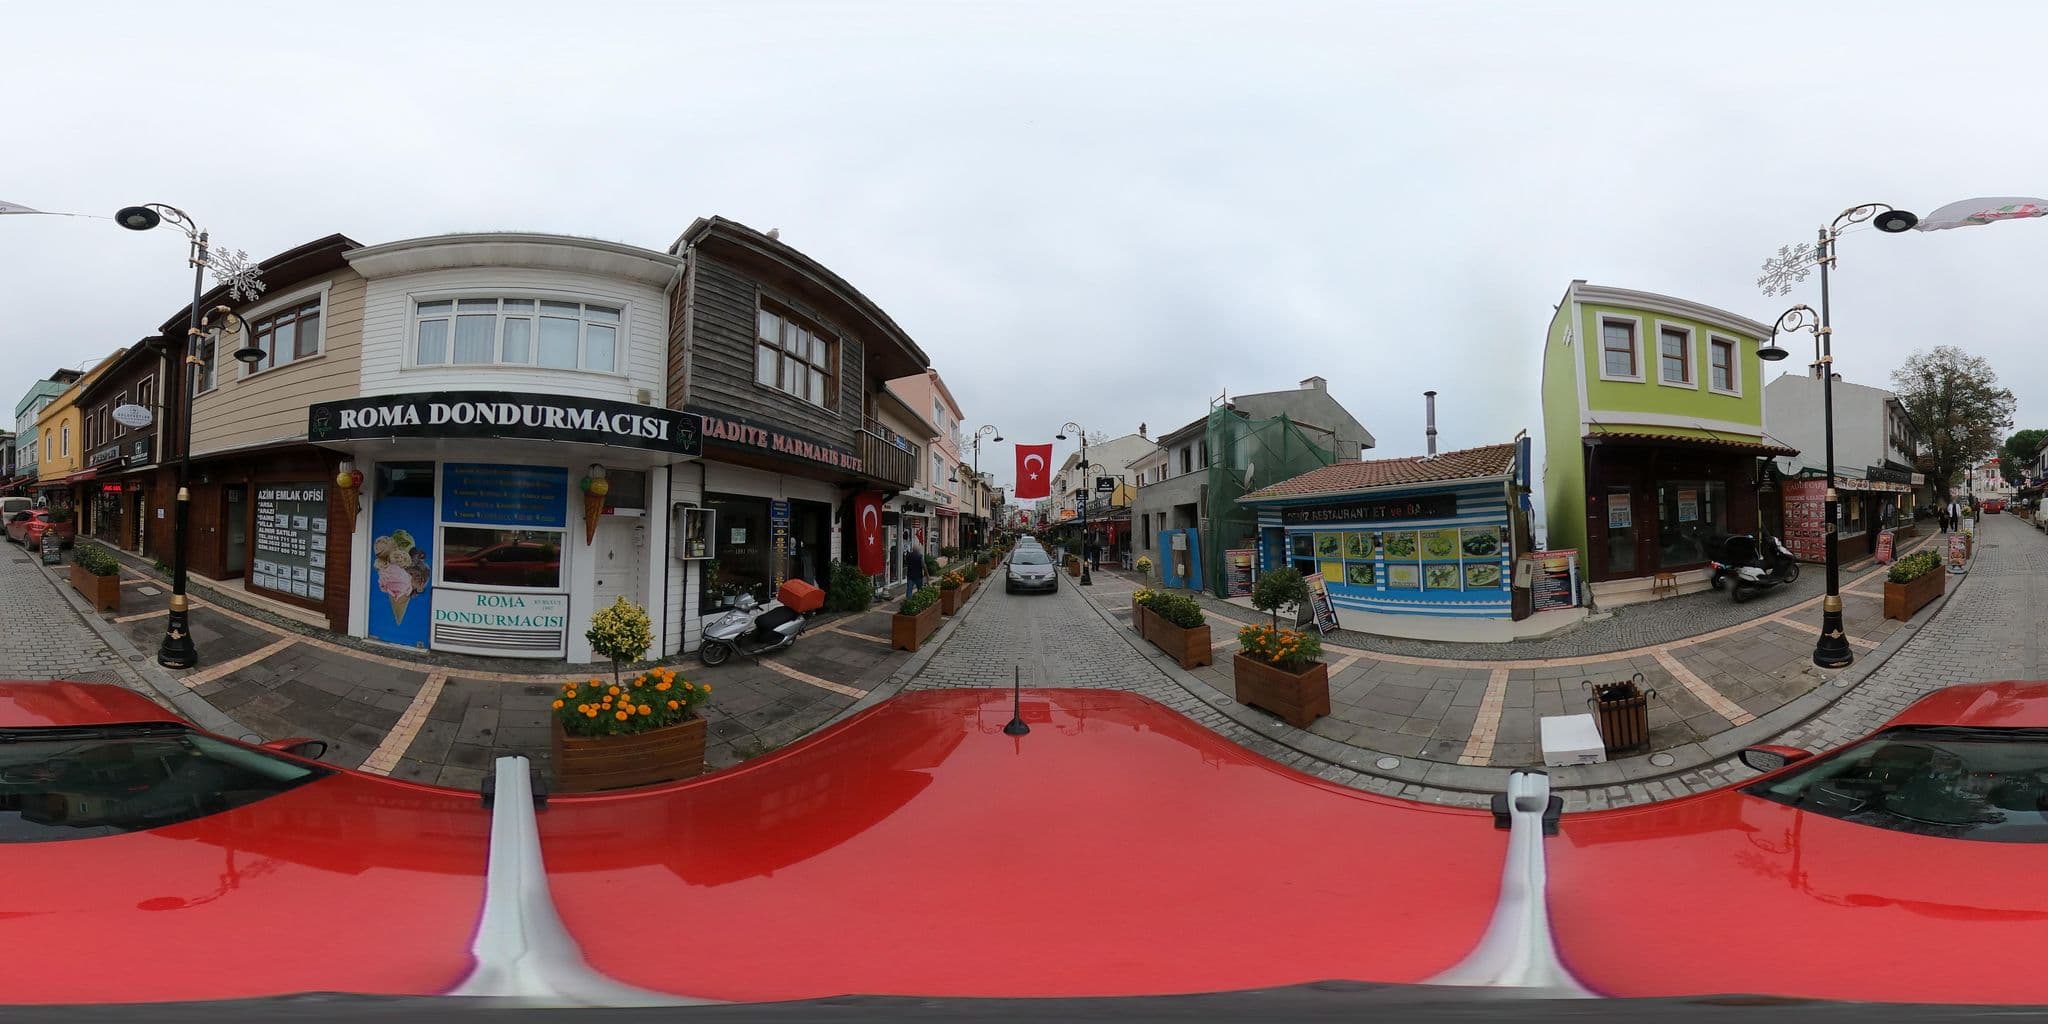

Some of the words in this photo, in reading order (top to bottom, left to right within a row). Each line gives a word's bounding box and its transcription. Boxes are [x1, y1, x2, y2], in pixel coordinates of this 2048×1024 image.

[339, 404, 421, 429] ROMA
[428, 402, 669, 440] DONDURMACISI
[702, 415, 768, 448] UADİYE
[258, 489, 274, 500] AZİM
[275, 490, 300, 501] EMLAK
[303, 488, 323, 502] OFİSİ
[1312, 506, 1370, 521] RESTAURANT
[477, 594, 525, 608] ROMA
[435, 609, 563, 628] DONDURMACISI
